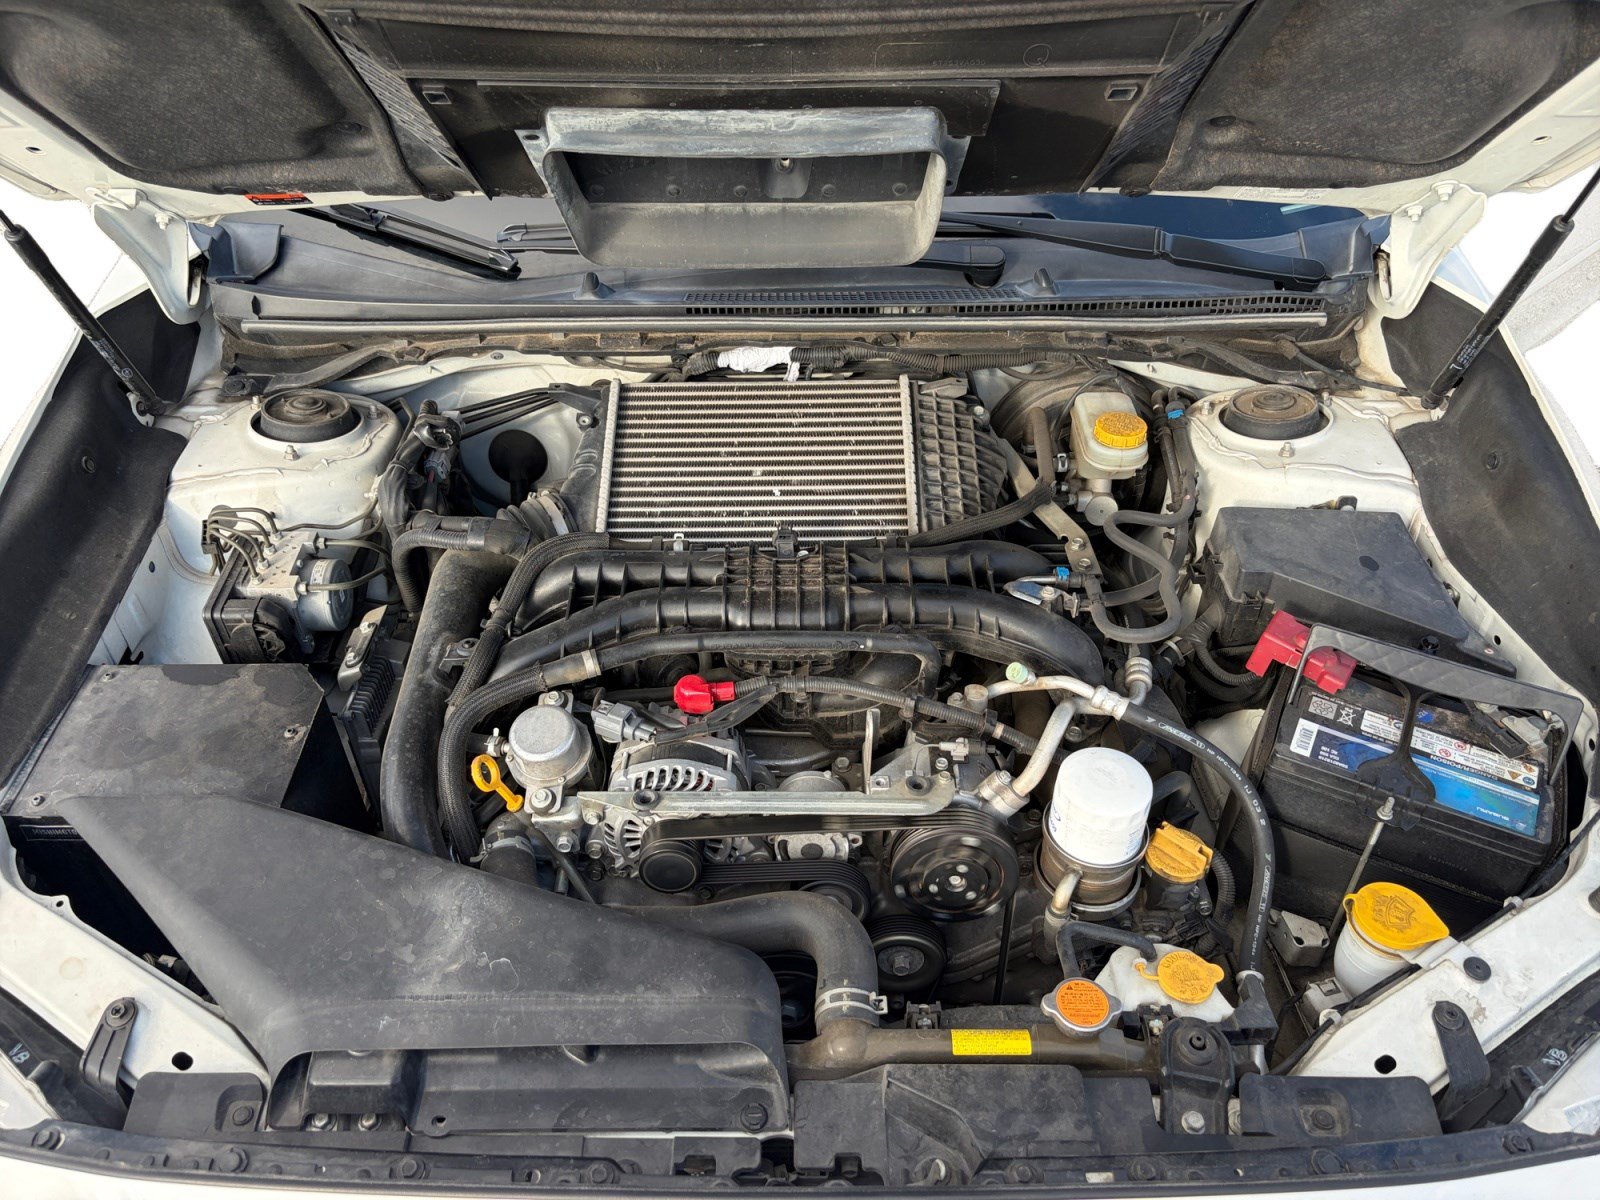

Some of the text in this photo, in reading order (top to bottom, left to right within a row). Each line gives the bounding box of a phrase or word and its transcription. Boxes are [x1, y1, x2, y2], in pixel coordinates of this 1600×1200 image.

[1429, 754, 1498, 780] DANGER/POISON
[1476, 806, 1510, 821] SUBARU
[8, 1042, 30, 1064] VB
[1541, 1047, 1568, 1066] VB
